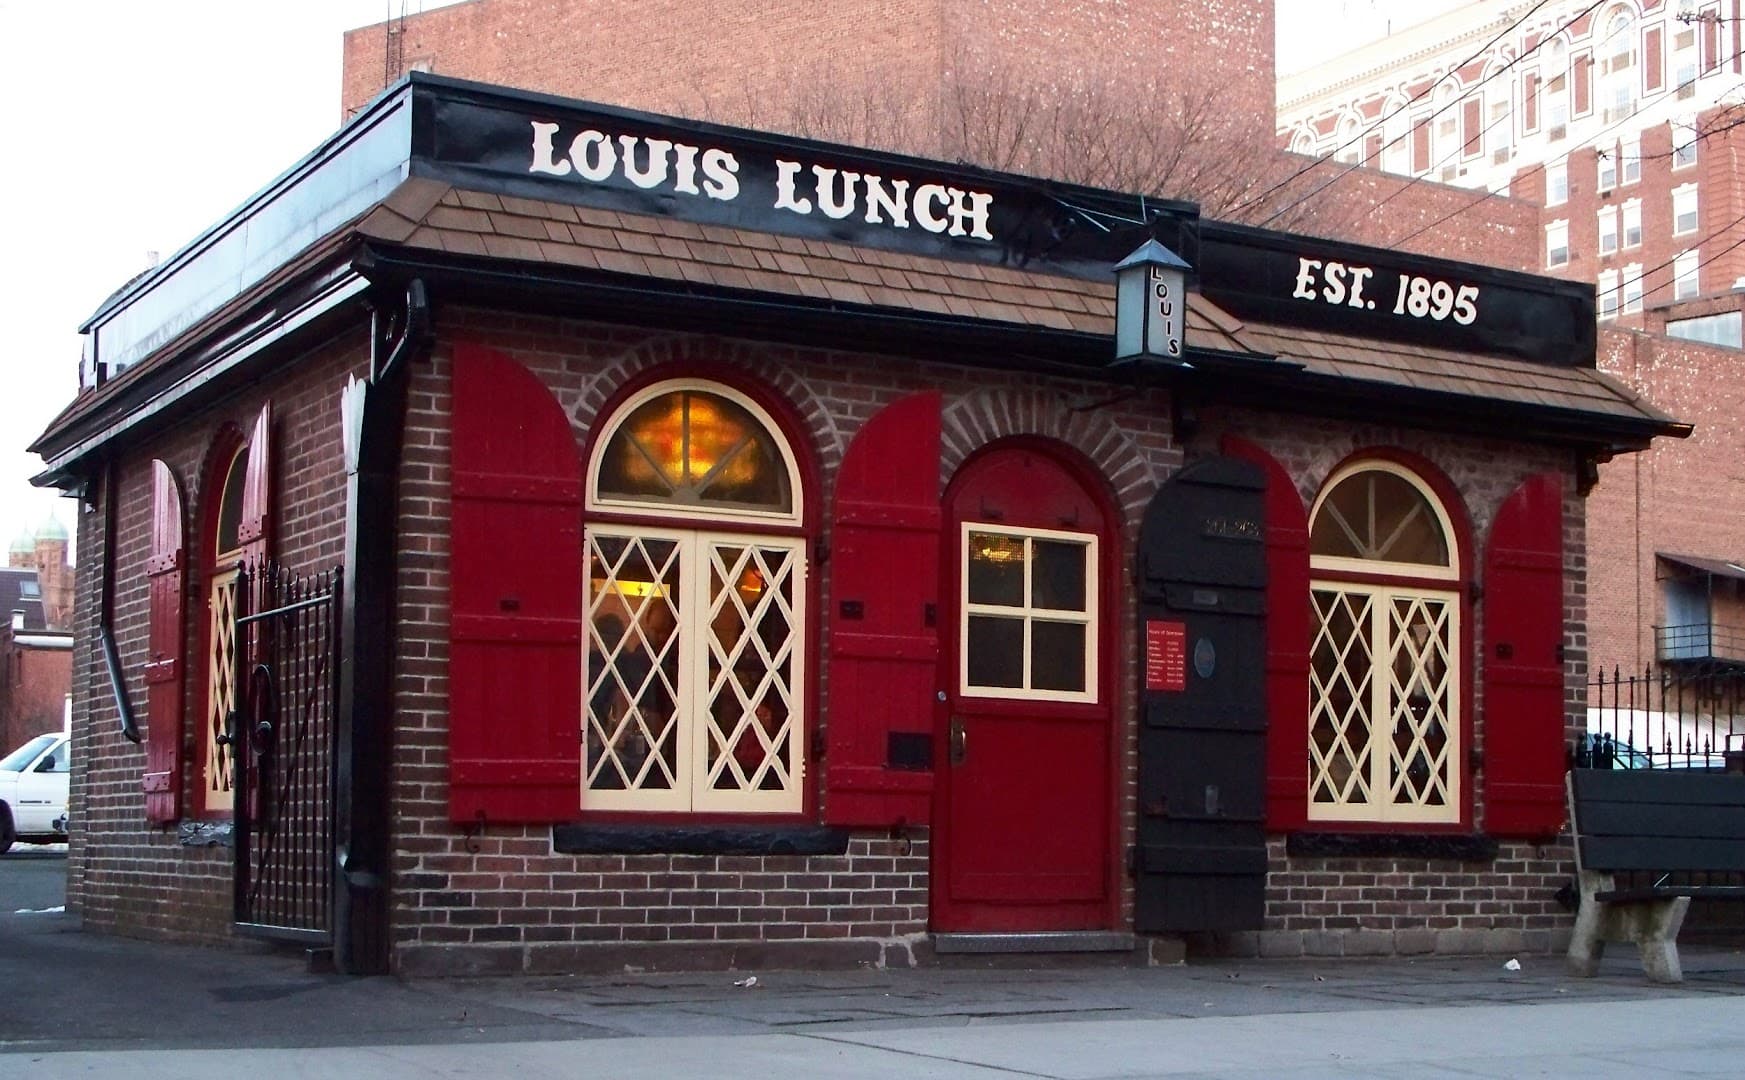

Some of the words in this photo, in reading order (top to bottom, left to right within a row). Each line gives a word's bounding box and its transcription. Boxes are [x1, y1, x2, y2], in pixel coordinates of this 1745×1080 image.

[529, 120, 741, 201] LOUIS
[774, 158, 994, 241] LUNCH
[1150, 264, 1180, 356] LOUIS
[1293, 257, 1376, 310] EST.
[1393, 274, 1479, 325] 1895
